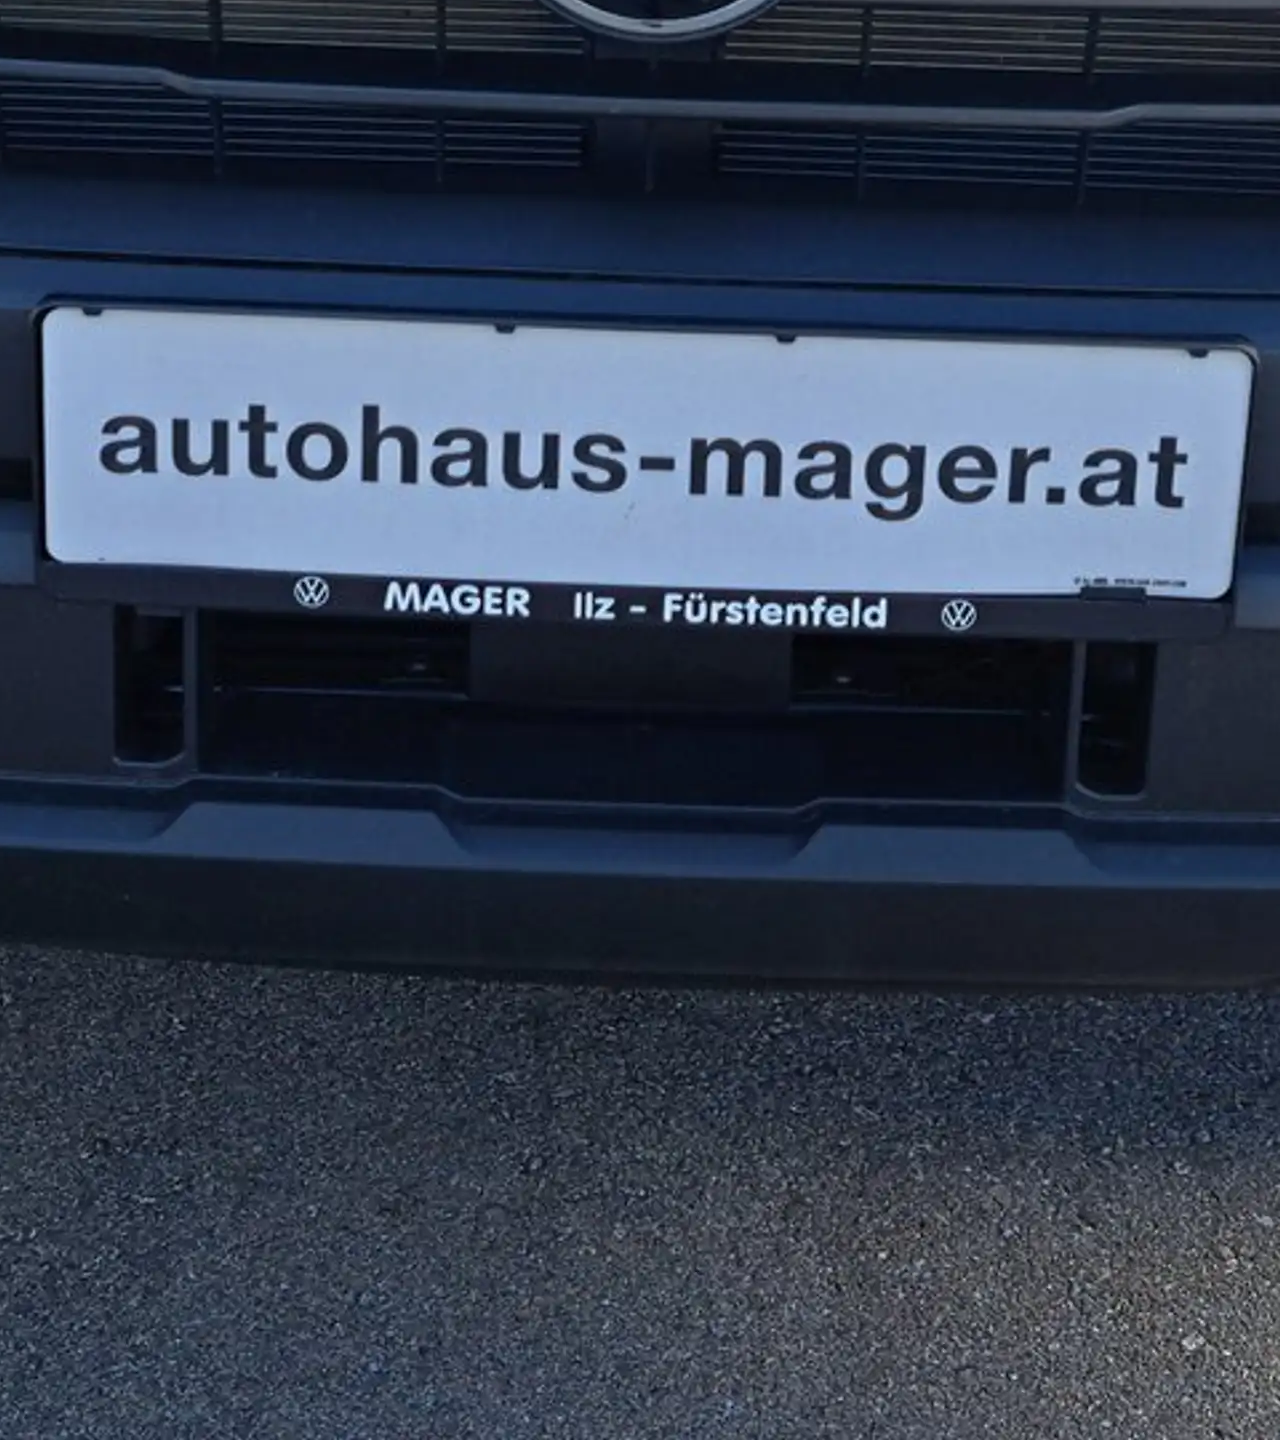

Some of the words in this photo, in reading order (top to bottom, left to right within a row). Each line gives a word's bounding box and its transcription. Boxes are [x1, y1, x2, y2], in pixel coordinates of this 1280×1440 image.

[98, 402, 1188, 522] autohaus-mager.at
[383, 580, 532, 618] MAGER
[573, 591, 616, 621] Ilz
[662, 592, 888, 629] Fürstenfeld
